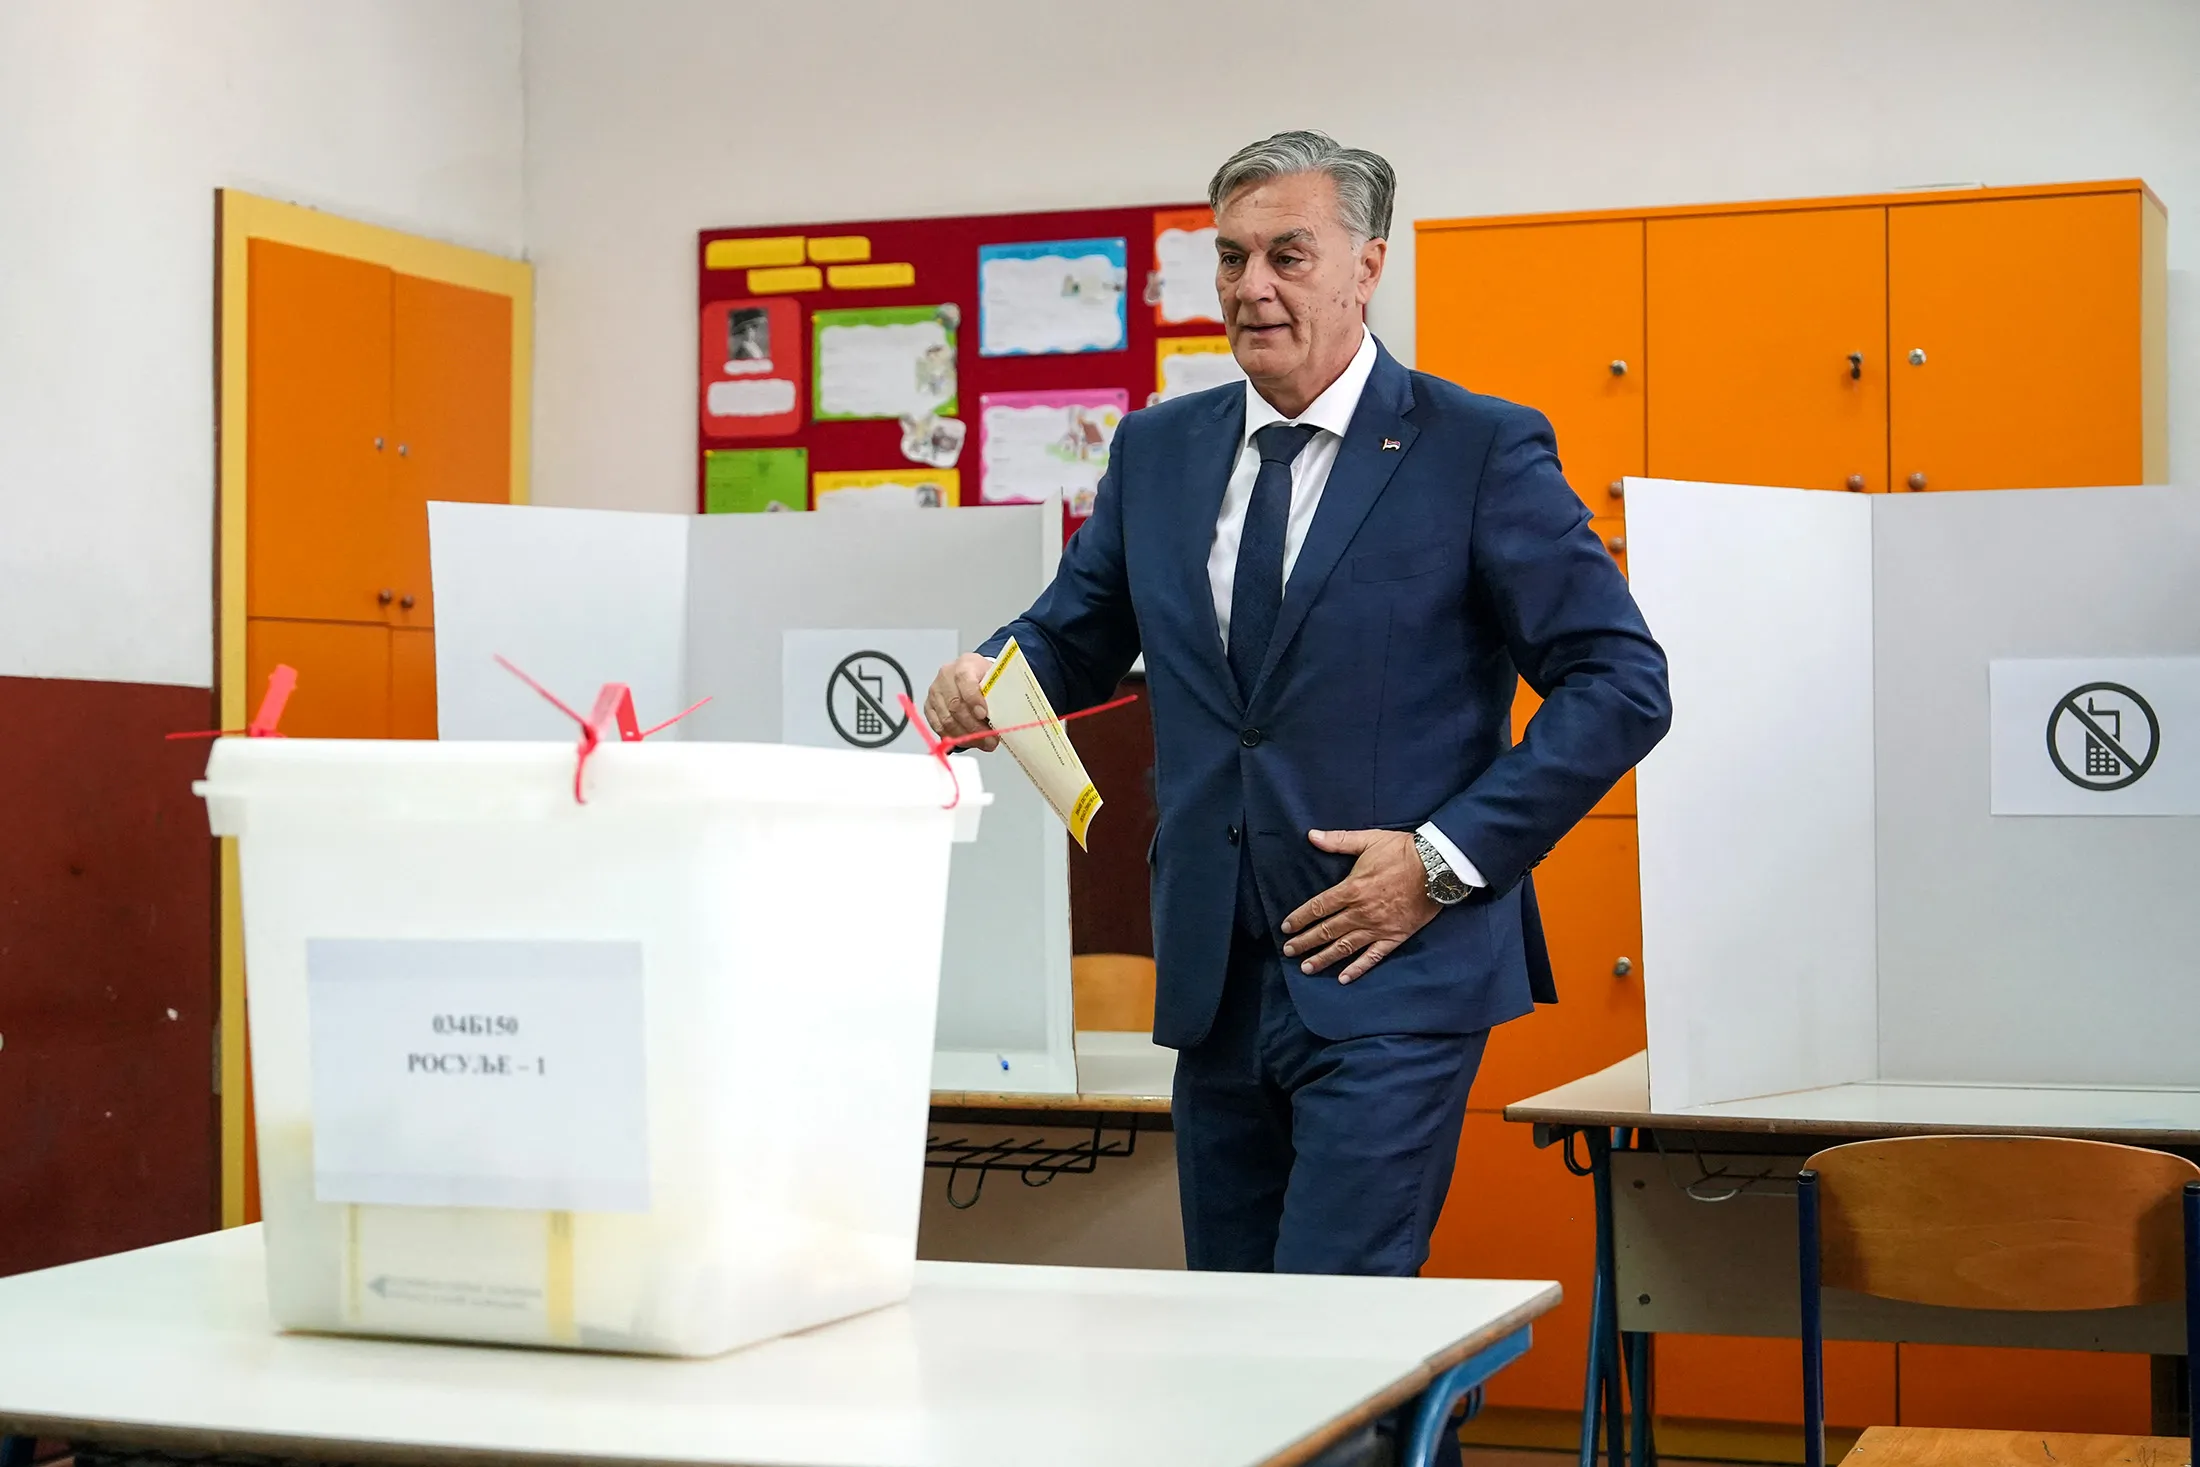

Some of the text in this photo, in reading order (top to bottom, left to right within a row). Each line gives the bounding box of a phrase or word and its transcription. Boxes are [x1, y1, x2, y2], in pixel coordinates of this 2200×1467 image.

[432, 1014, 519, 1035] 034Б150
[407, 1053, 511, 1075] РОСУЉЕ
[537, 1056, 546, 1075] 1
